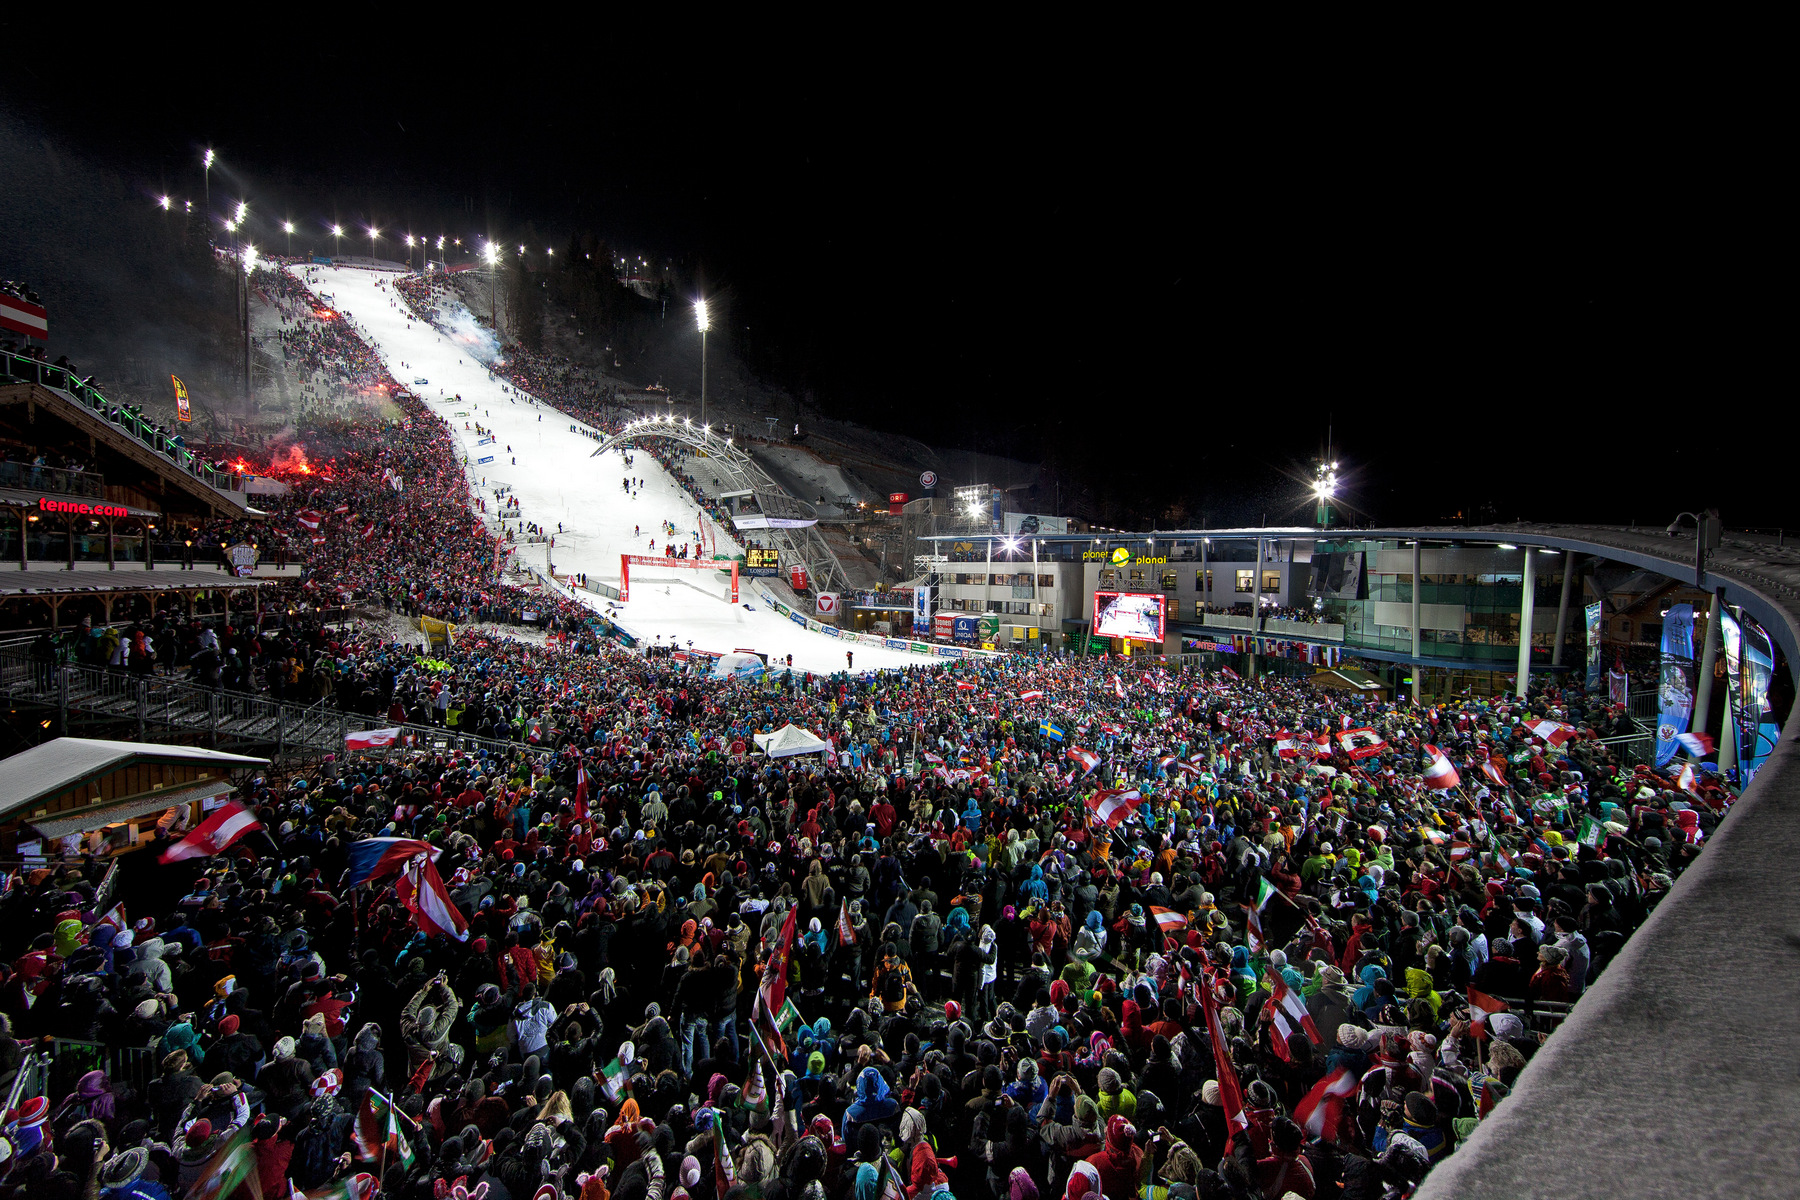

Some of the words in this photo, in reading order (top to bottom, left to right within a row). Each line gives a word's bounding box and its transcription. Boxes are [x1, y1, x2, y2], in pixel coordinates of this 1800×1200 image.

[39, 497, 128, 517] tenne.com
[1082, 550, 1109, 560] planet
[1136, 555, 1167, 566] planai
